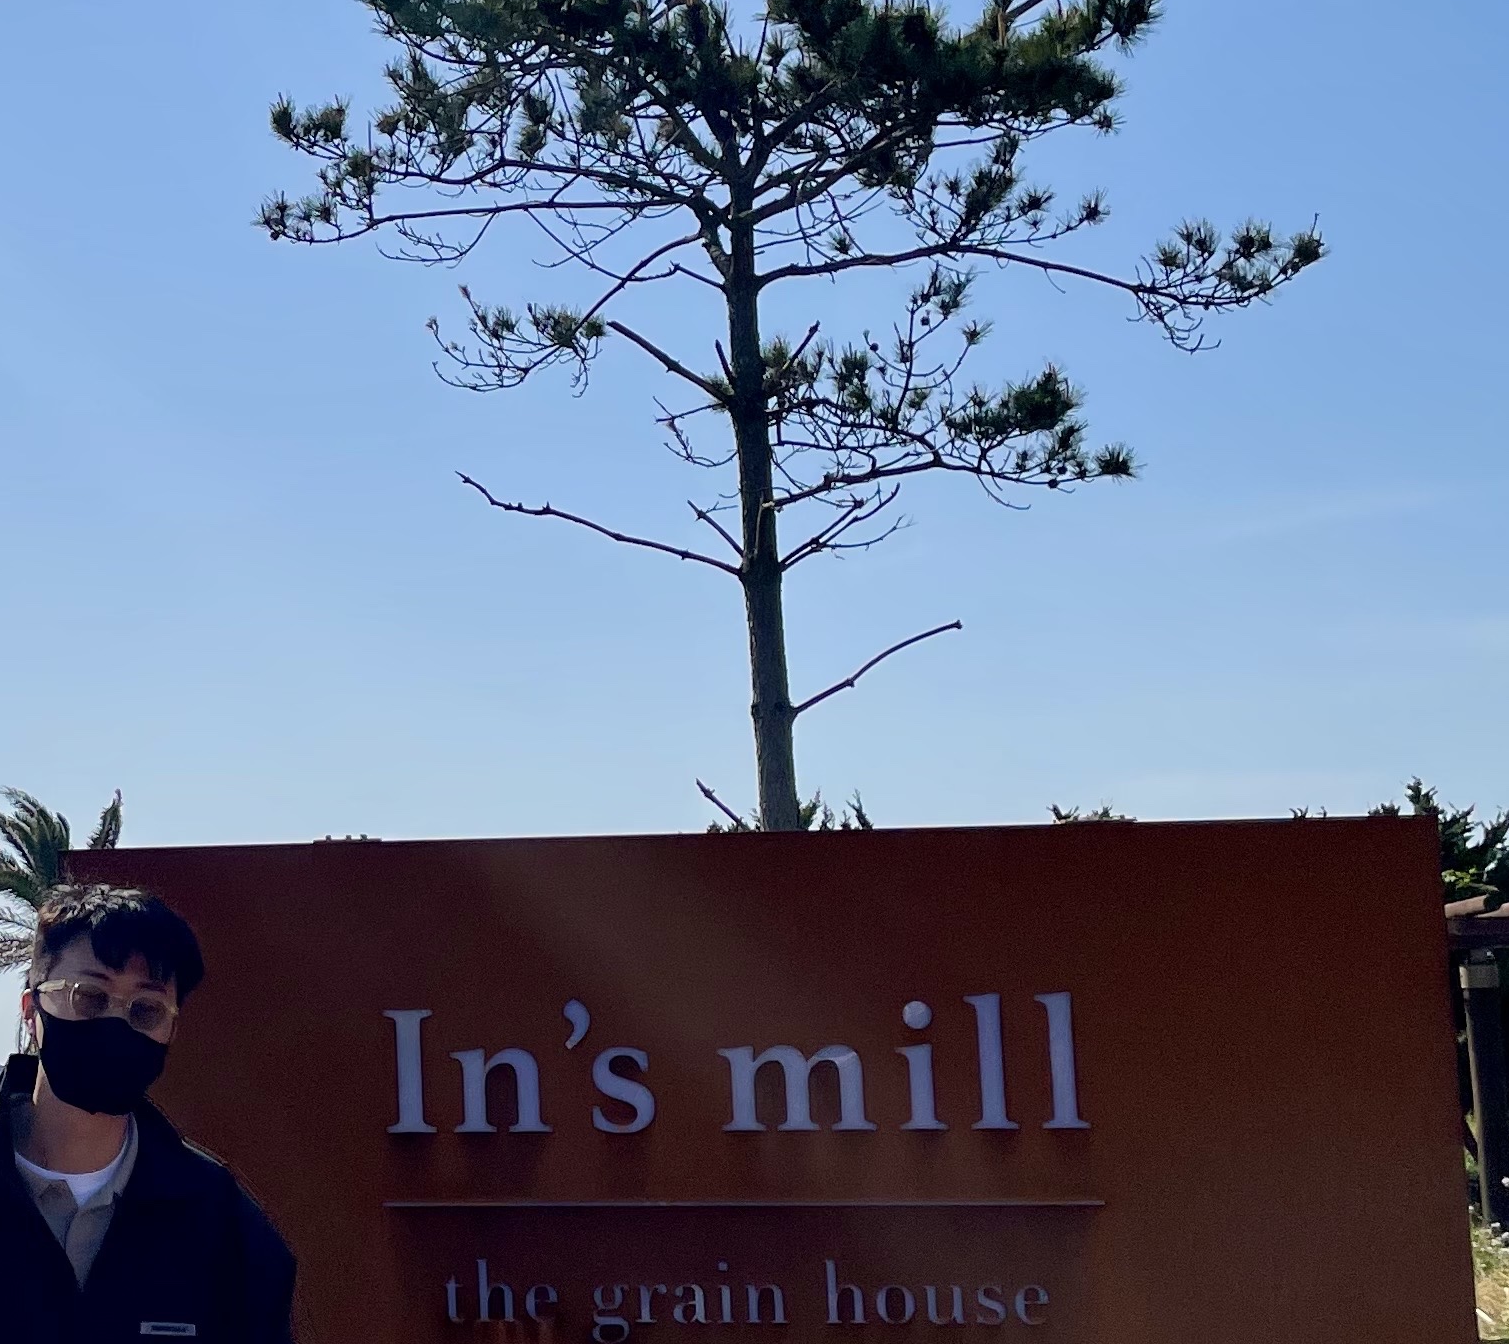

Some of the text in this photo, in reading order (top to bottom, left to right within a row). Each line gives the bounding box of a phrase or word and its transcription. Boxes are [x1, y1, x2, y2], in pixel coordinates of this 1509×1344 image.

[383, 991, 1091, 1134] In's mill
[445, 1258, 1051, 1344] the grain house
